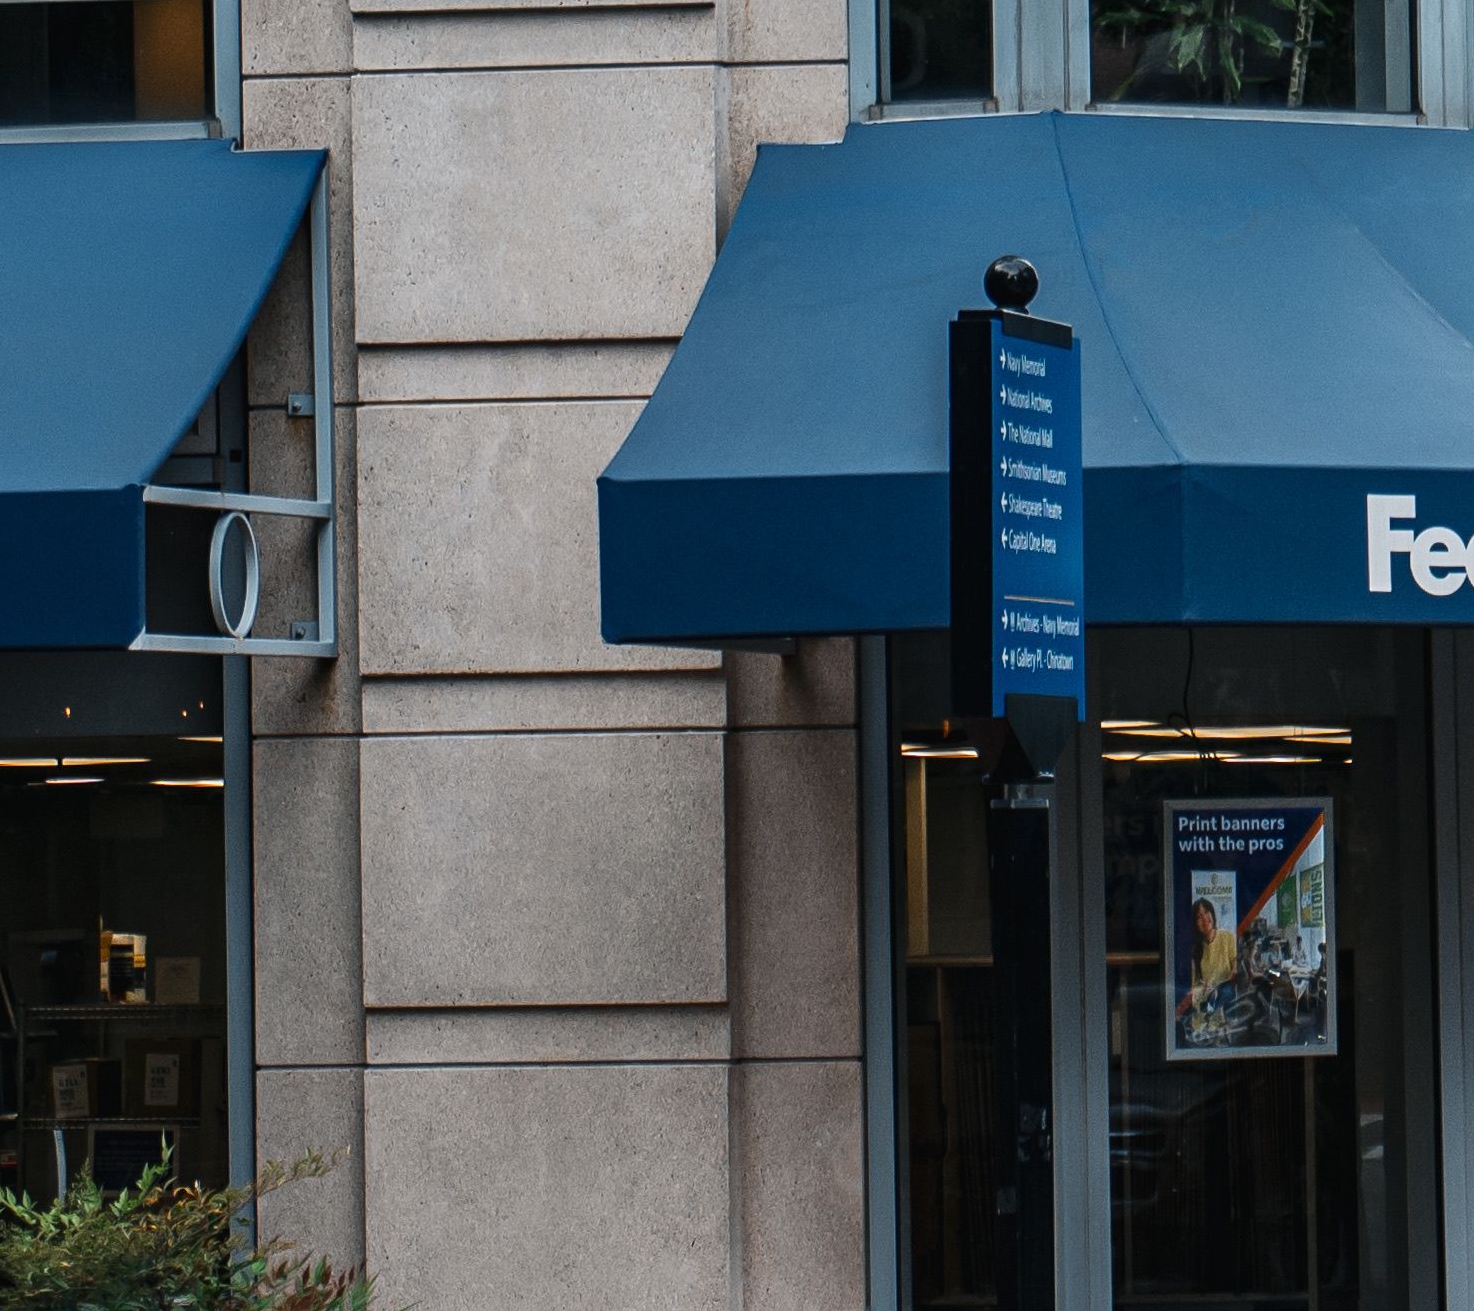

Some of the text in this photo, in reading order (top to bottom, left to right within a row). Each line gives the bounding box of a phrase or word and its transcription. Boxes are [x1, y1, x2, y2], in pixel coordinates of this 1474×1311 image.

[1007, 352, 1045, 378] Navy Memorial
[1007, 388, 1053, 414] National Archives
[1008, 422, 1053, 448] The National Mall
[1008, 458, 1066, 486] Smithsonian Museums
[1009, 494, 1042, 520] Shakespeare
[1009, 529, 1056, 554] Capital One Arena
[1016, 612, 1039, 633] Archives
[1043, 615, 1056, 639] Navy
[1057, 616, 1079, 636] Memorial
[1017, 648, 1036, 672] Gallery
[1047, 650, 1073, 670] Chinatown
[1179, 815, 1285, 832] Print banners
[1178, 835, 1284, 855] with the pros
